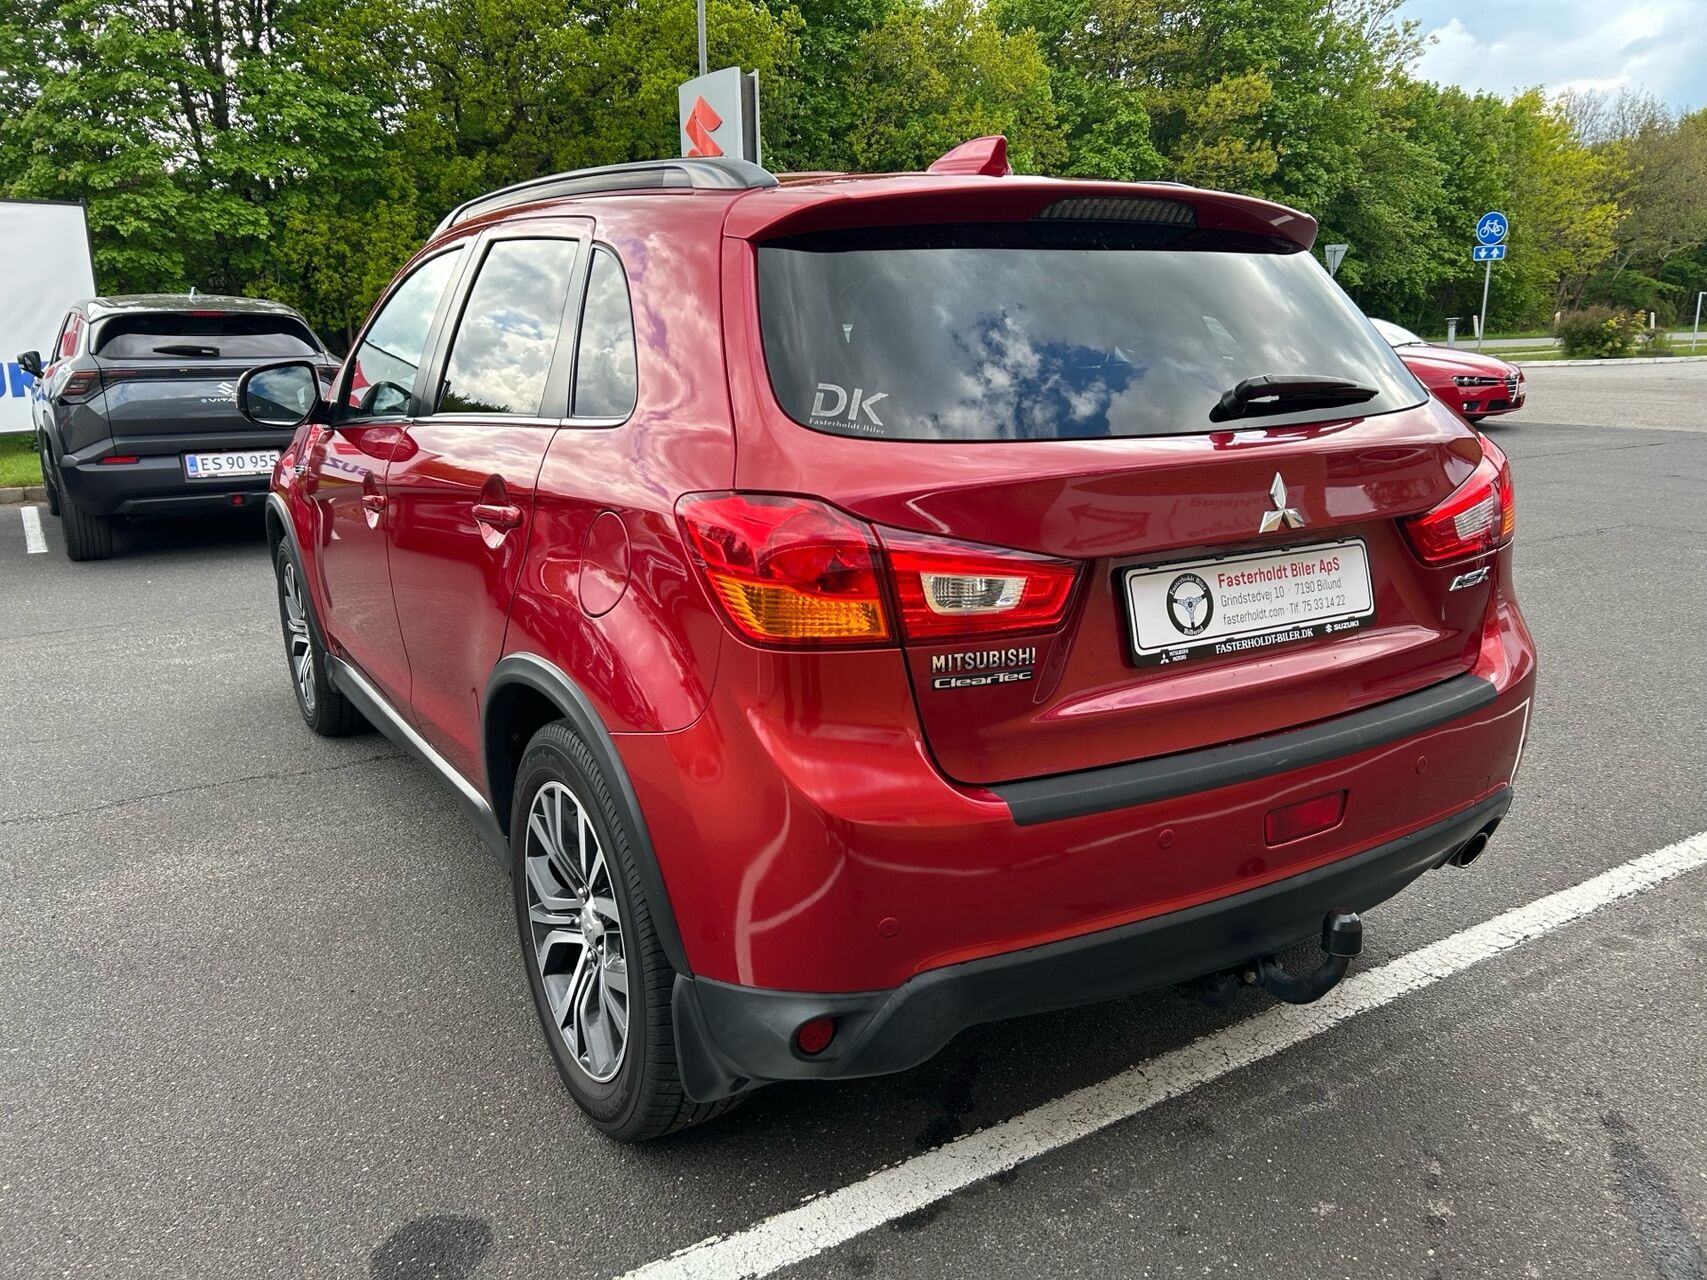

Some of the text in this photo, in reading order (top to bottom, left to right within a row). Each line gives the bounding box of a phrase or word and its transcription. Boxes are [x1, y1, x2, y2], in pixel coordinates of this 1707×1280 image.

[811, 382, 889, 426] DK
[809, 417, 885, 435] Fasterholdt Biler
[200, 454, 277, 471] ES 90 955
[1217, 556, 1340, 589] Fasterholdt Biler ApS
[1220, 577, 1342, 608] Grindstedvej 10 7190 Billund
[1223, 605, 1286, 626] fasterholdt.com
[1302, 600, 1313, 613] 75
[1314, 598, 1324, 611] 33
[1325, 596, 1335, 609] 14
[1336, 594, 1346, 607] 22
[1333, 620, 1360, 631] SUZUKI
[1215, 627, 1314, 655] FASTERHOLDT-BILER.DK
[931, 647, 1036, 674] MITSUBISHI
[934, 670, 1032, 690] ClearTec
